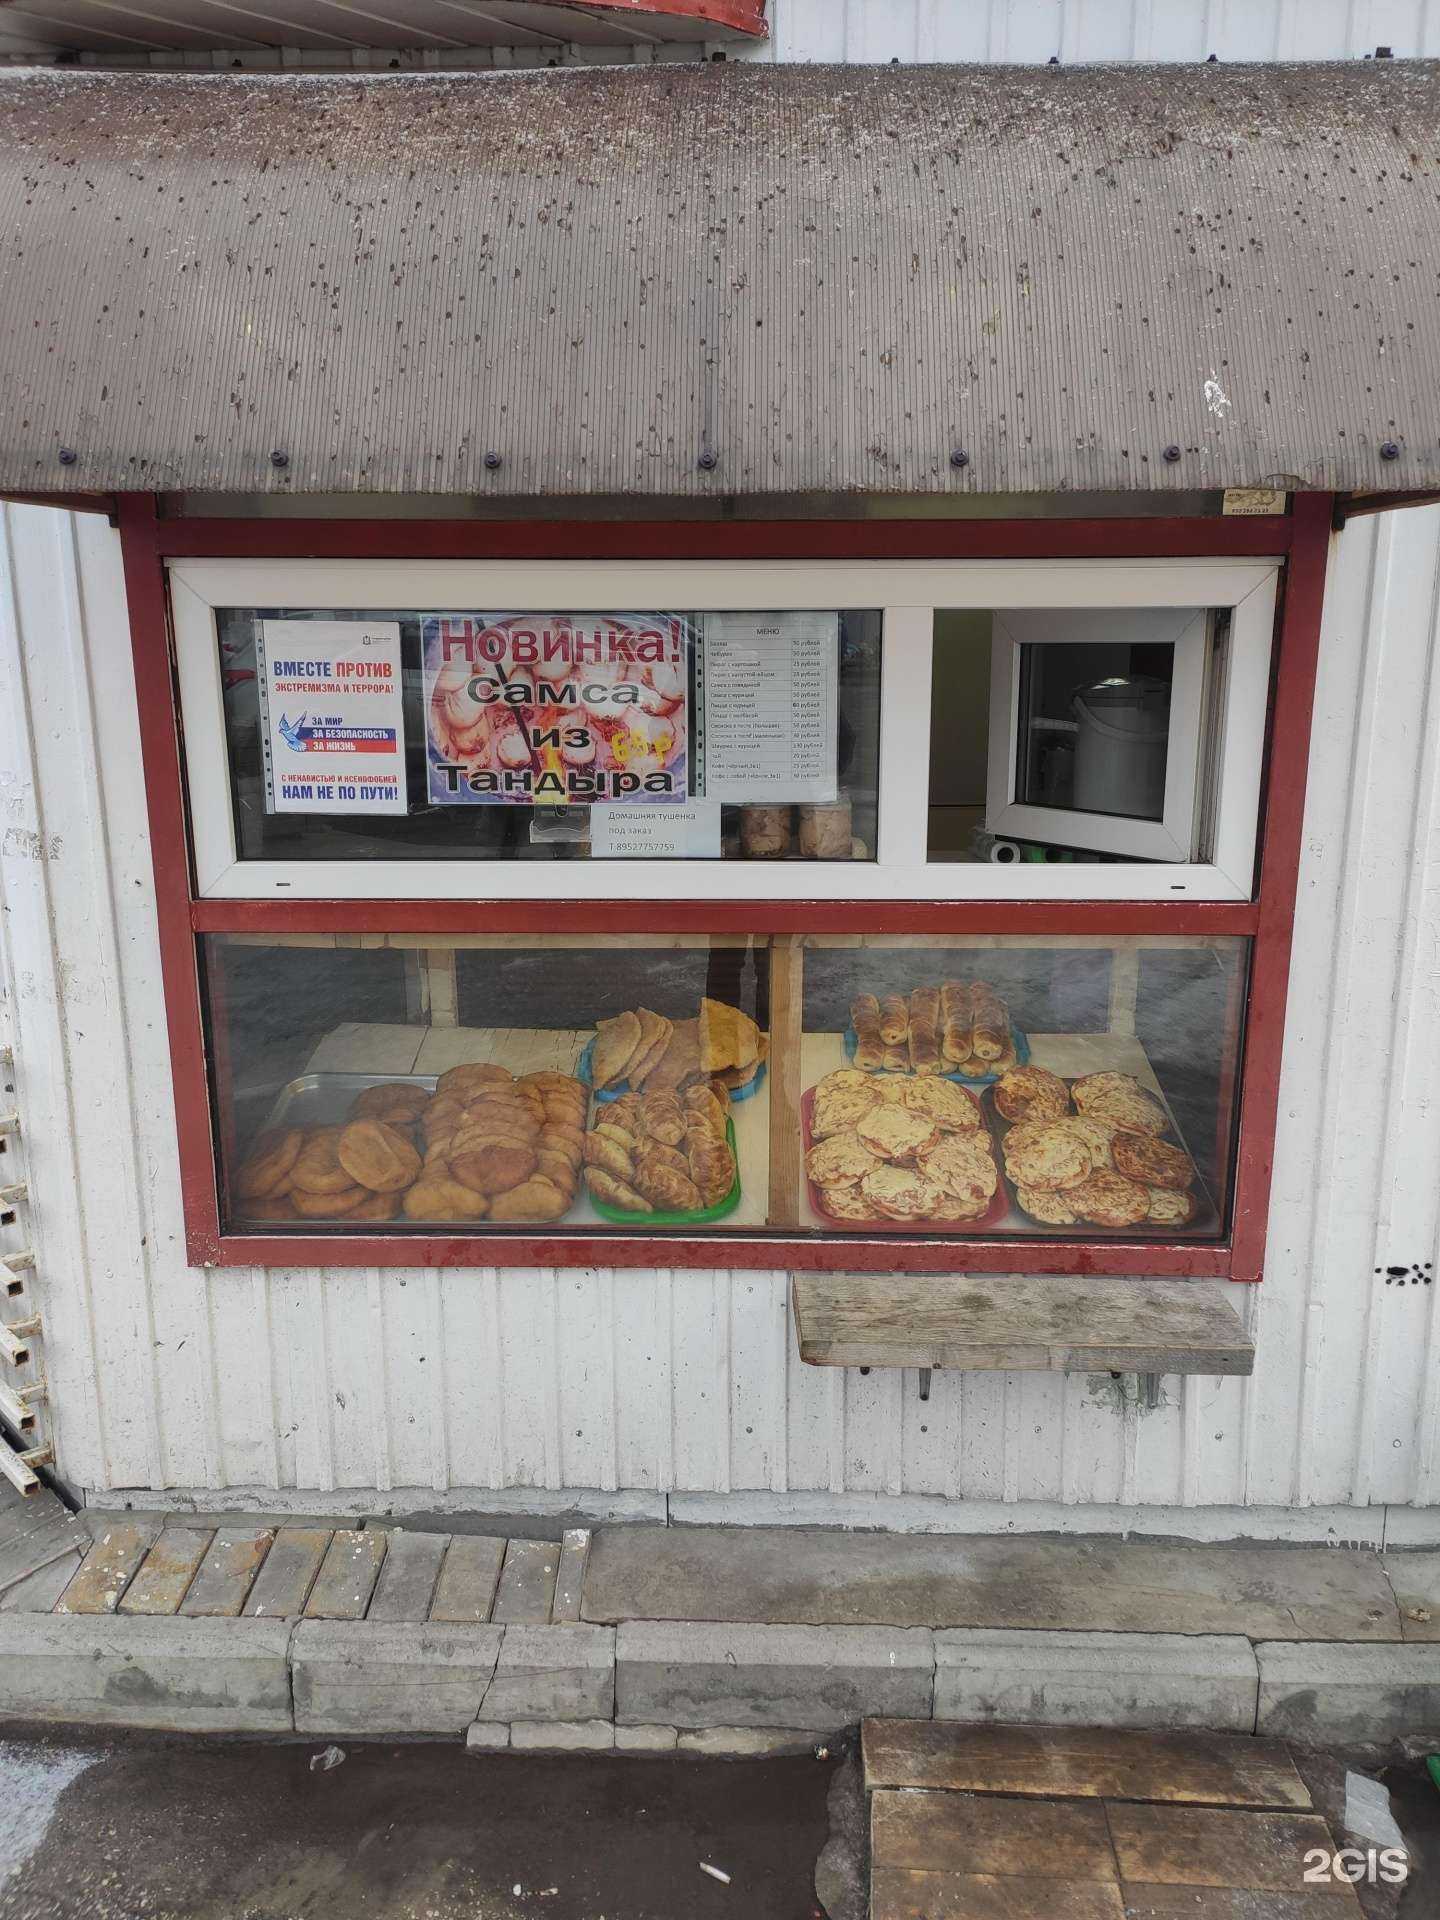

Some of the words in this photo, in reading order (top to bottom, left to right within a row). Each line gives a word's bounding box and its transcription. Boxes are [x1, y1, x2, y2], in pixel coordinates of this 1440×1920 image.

[441, 618, 682, 663] Новинка!
[273, 661, 331, 677] ВМЕСТЕ
[336, 661, 393, 677] ПРОТИВ
[275, 683, 341, 693] ЭКСТРЕМИЗМА
[343, 684, 350, 693] И
[352, 684, 394, 693] ТЕРРОРА!
[467, 676, 640, 704] Самса
[312, 717, 323, 725] ЗА
[325, 717, 343, 726] МИР
[312, 729, 324, 738] ЗА
[325, 729, 389, 739] БЕЗОПАСНОСТЬ
[532, 727, 591, 749] из
[313, 742, 324, 750] ЗА
[325, 741, 356, 751] ЖИЗНЬ
[288, 775, 336, 783] НЕНАВИСТЬЮ
[437, 765, 673, 797] Тандыра
[282, 785, 313, 799] НАМ
[317, 786, 334, 800] НЕ
[338, 786, 355, 800] ПО
[360, 786, 398, 800] ПУТИ!
[608, 812, 656, 820] Домашняя
[659, 813, 696, 821] тушенка
[628, 827, 652, 835] заказ
